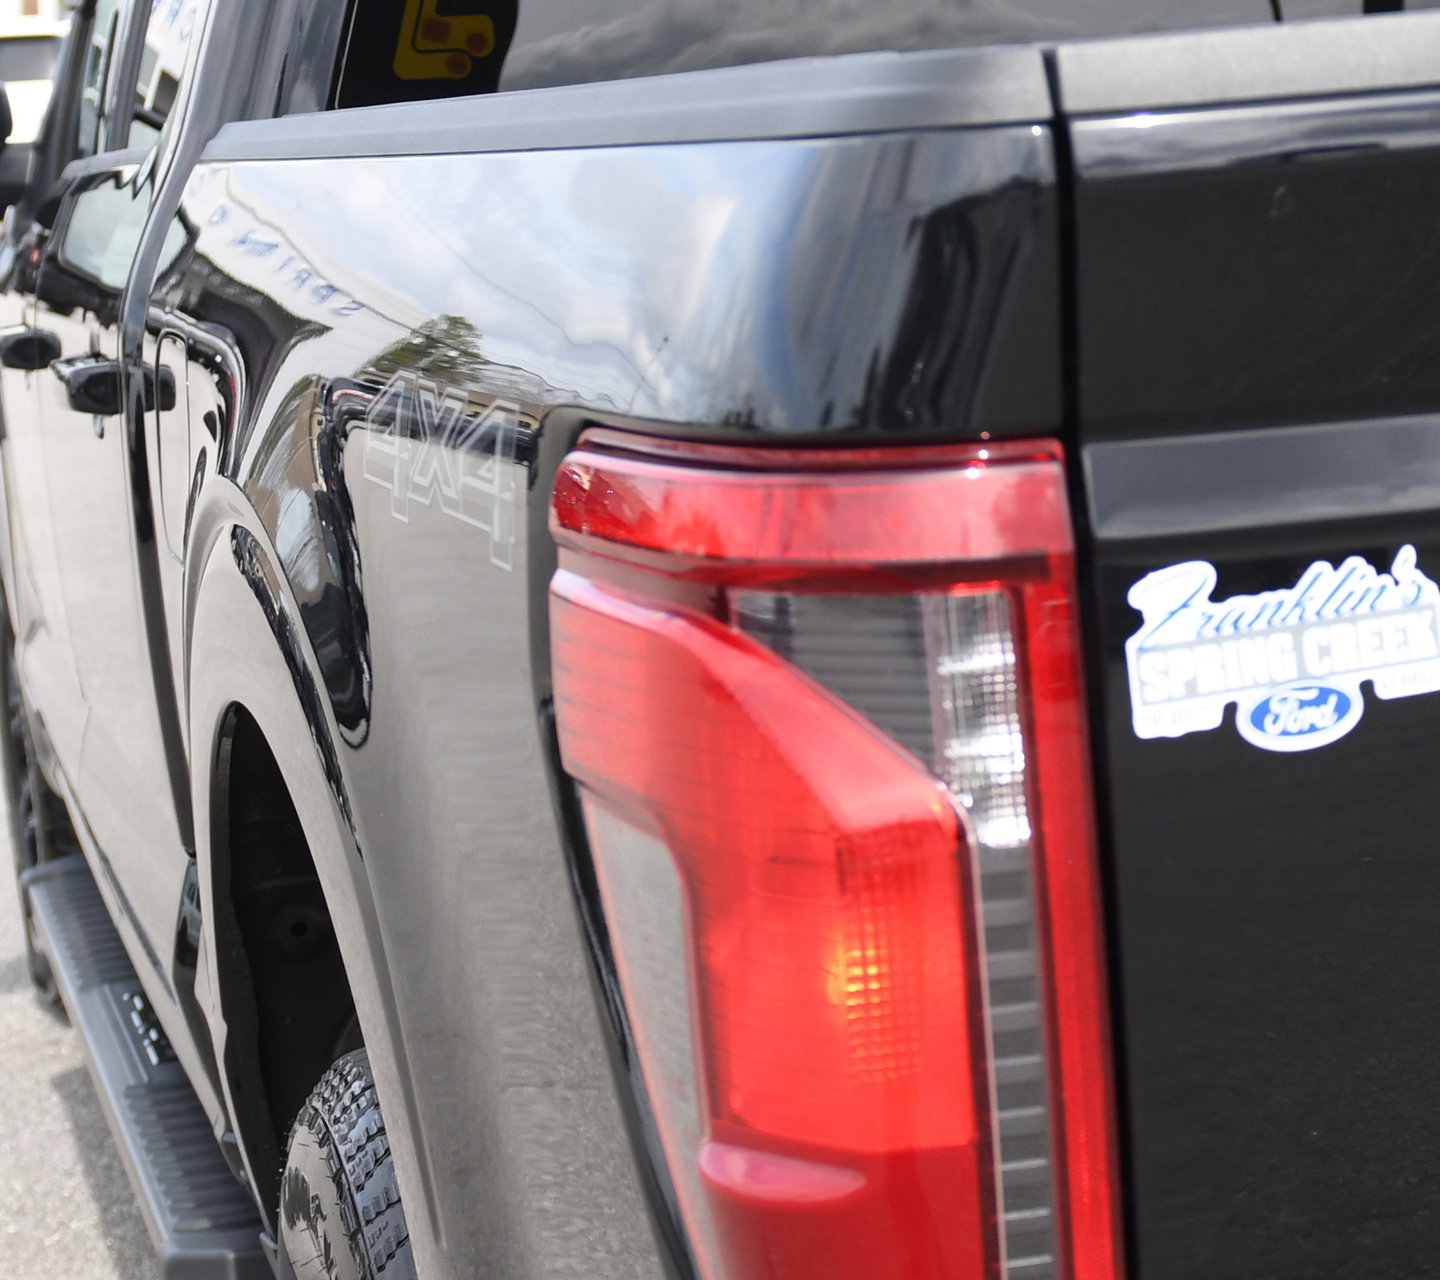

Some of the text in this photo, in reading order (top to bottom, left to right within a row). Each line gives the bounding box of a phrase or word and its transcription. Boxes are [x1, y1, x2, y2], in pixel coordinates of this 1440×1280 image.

[1138, 608, 1439, 704] SPRING CREEK
[1263, 687, 1339, 736] Ford
